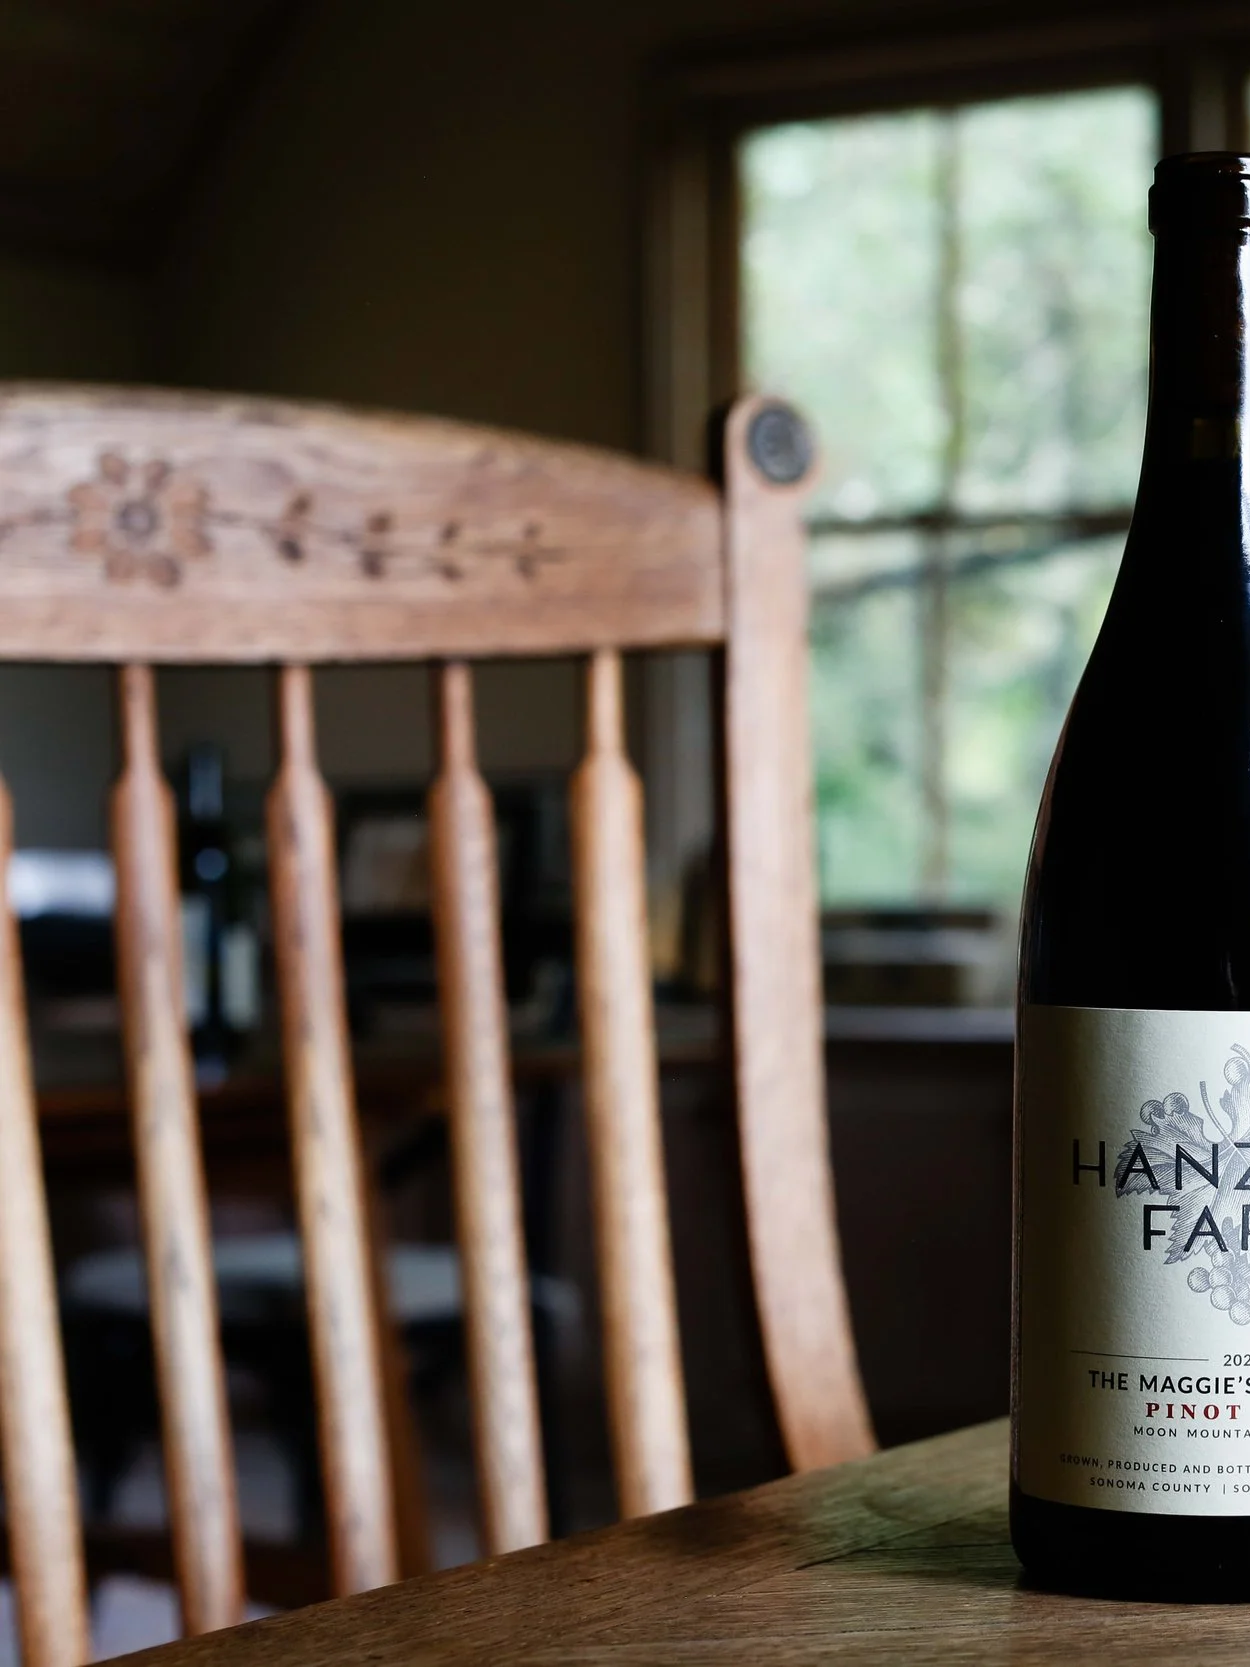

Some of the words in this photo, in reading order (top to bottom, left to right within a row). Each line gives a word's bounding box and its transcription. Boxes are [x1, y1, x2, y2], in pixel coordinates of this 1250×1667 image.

[1088, 1369, 1129, 1391] THE
[1145, 1402, 1241, 1421] PINOT
[1133, 1425, 1178, 1438] MOON
[1107, 1459, 1177, 1473] PRODUCED
[1182, 1464, 1211, 1474] AND
[1089, 1476, 1146, 1491] SONOMA
[1152, 1482, 1211, 1494] COUNTY
